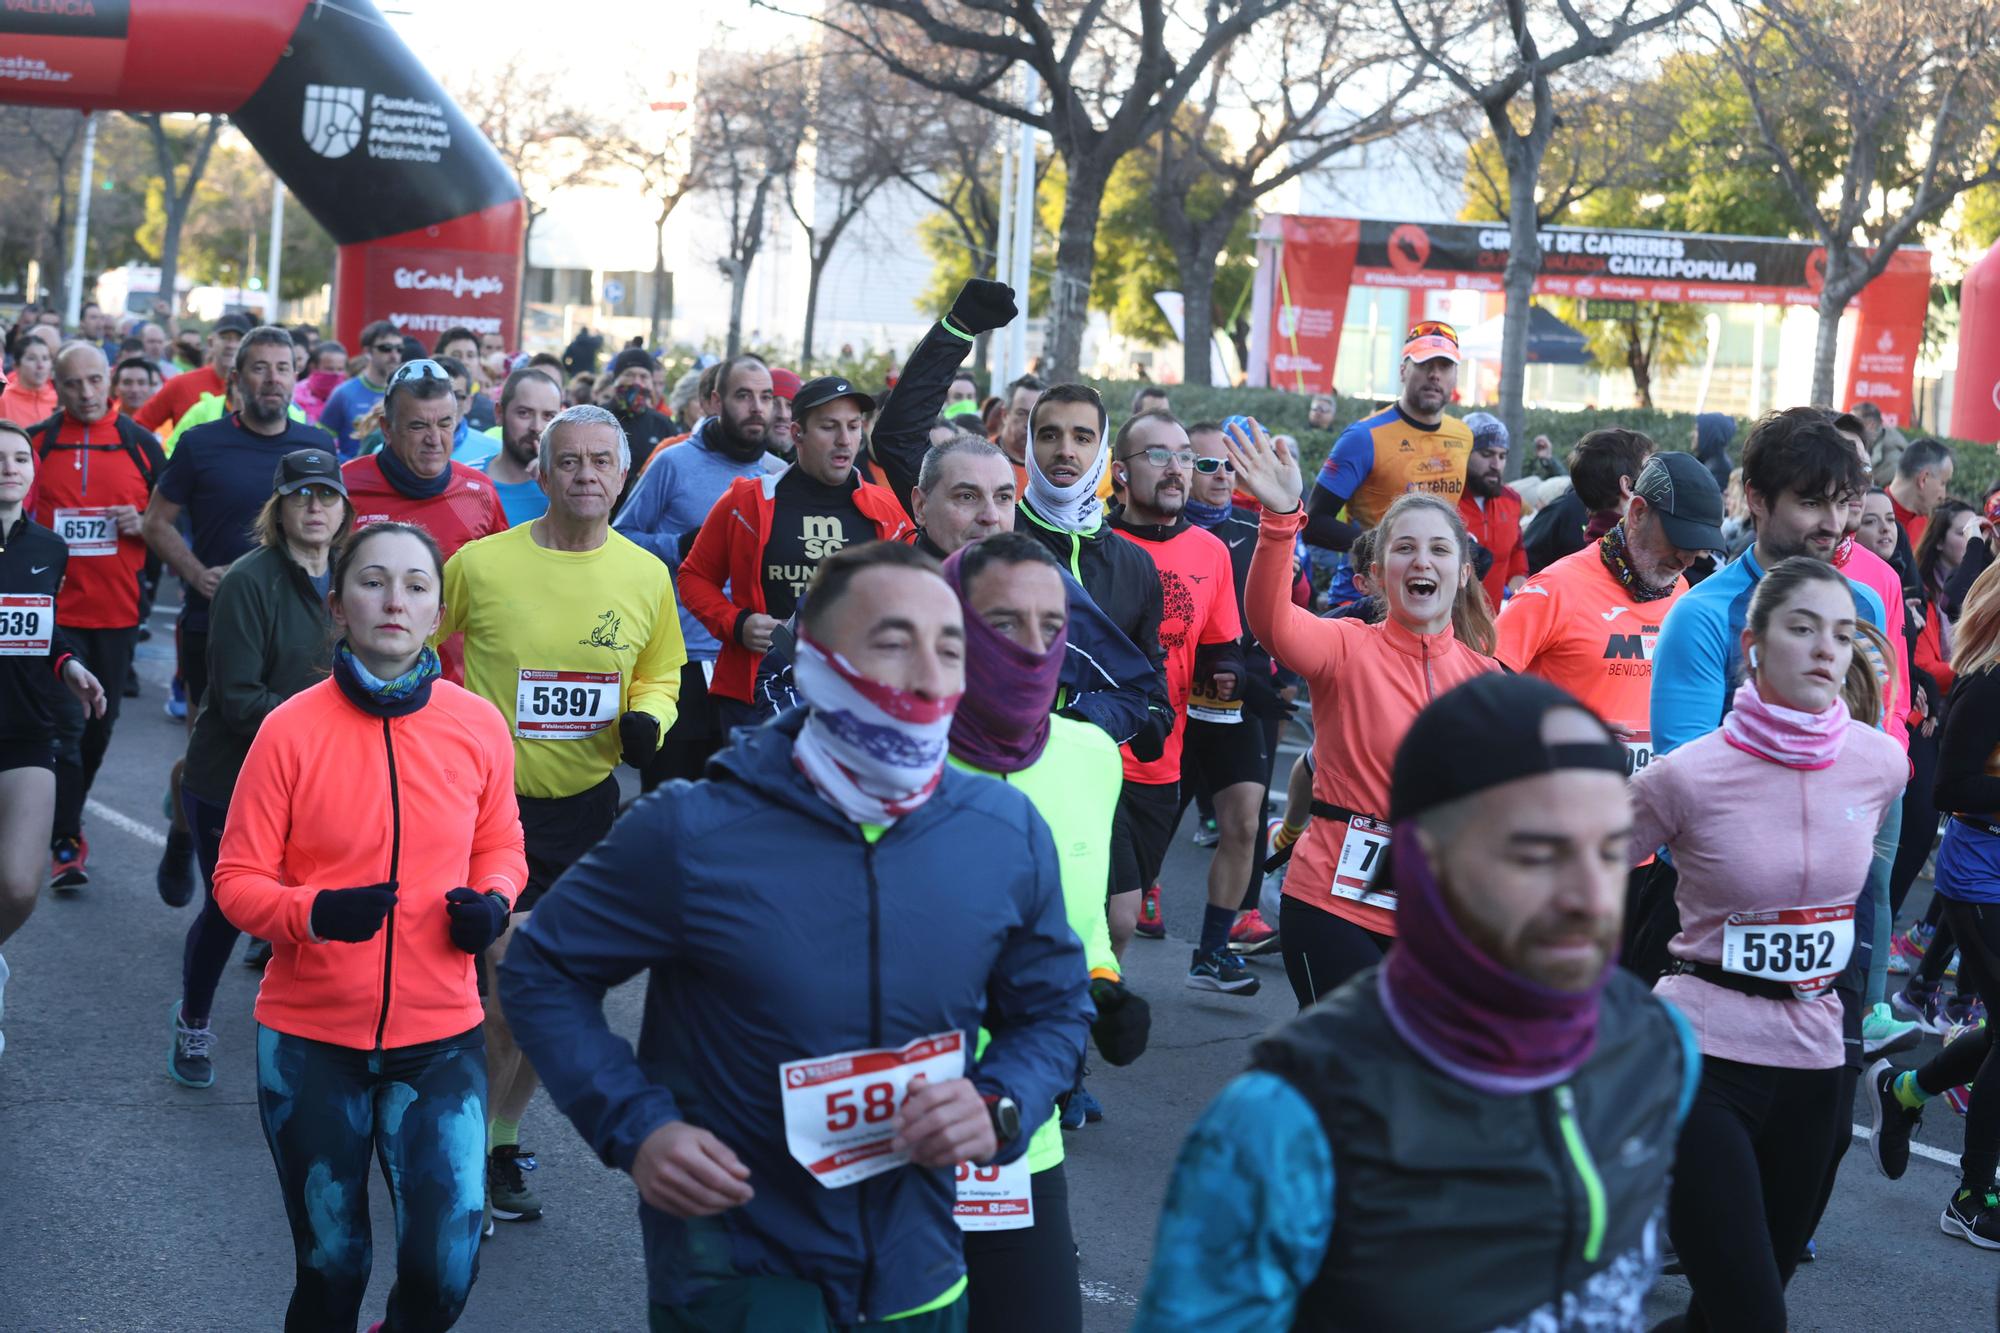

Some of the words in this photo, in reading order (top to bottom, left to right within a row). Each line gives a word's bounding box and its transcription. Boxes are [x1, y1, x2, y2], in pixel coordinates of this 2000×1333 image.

[1557, 234, 1583, 254] DE
[1584, 235, 1685, 259] CARRERES
[64, 520, 106, 539] 6572
[532, 686, 602, 717] 5397
[1743, 930, 1835, 973] 5352
